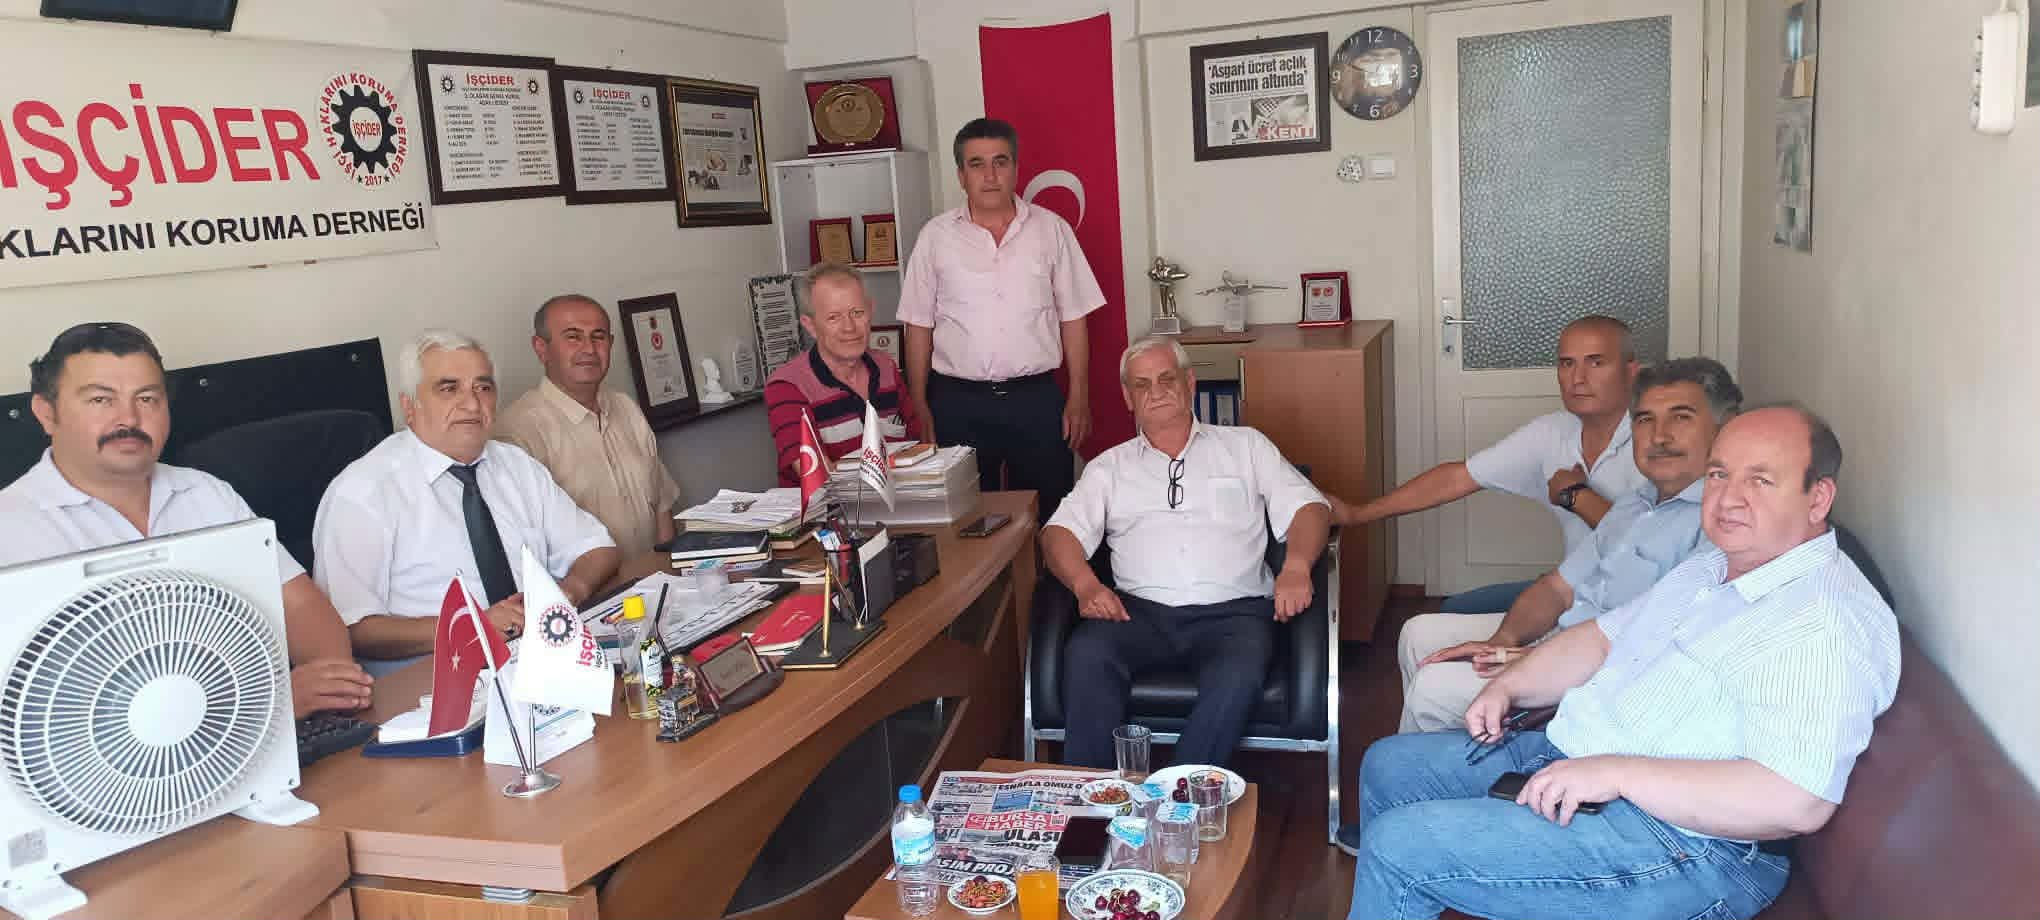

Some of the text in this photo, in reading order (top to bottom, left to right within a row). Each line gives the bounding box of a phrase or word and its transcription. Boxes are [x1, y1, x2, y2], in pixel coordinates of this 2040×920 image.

[1367, 29, 1384, 44] 12
[1248, 59, 1277, 75] ücret
[1279, 55, 1307, 73] açlık
[1408, 63, 1418, 78] 3
[1332, 70, 1341, 85] 9
[350, 73, 398, 112] KORUMA
[1209, 78, 1258, 95] sınırının
[1369, 104, 1380, 118] 6
[364, 176, 382, 186] 2017
[166, 214, 308, 248] KORUMA
[312, 202, 426, 238] DERNEĞİ
[998, 780, 1041, 790] ESNAFLA
[1043, 781, 1074, 789] OMUZ
[990, 812, 1047, 823] BURSA
[984, 821, 1047, 830] HABER
